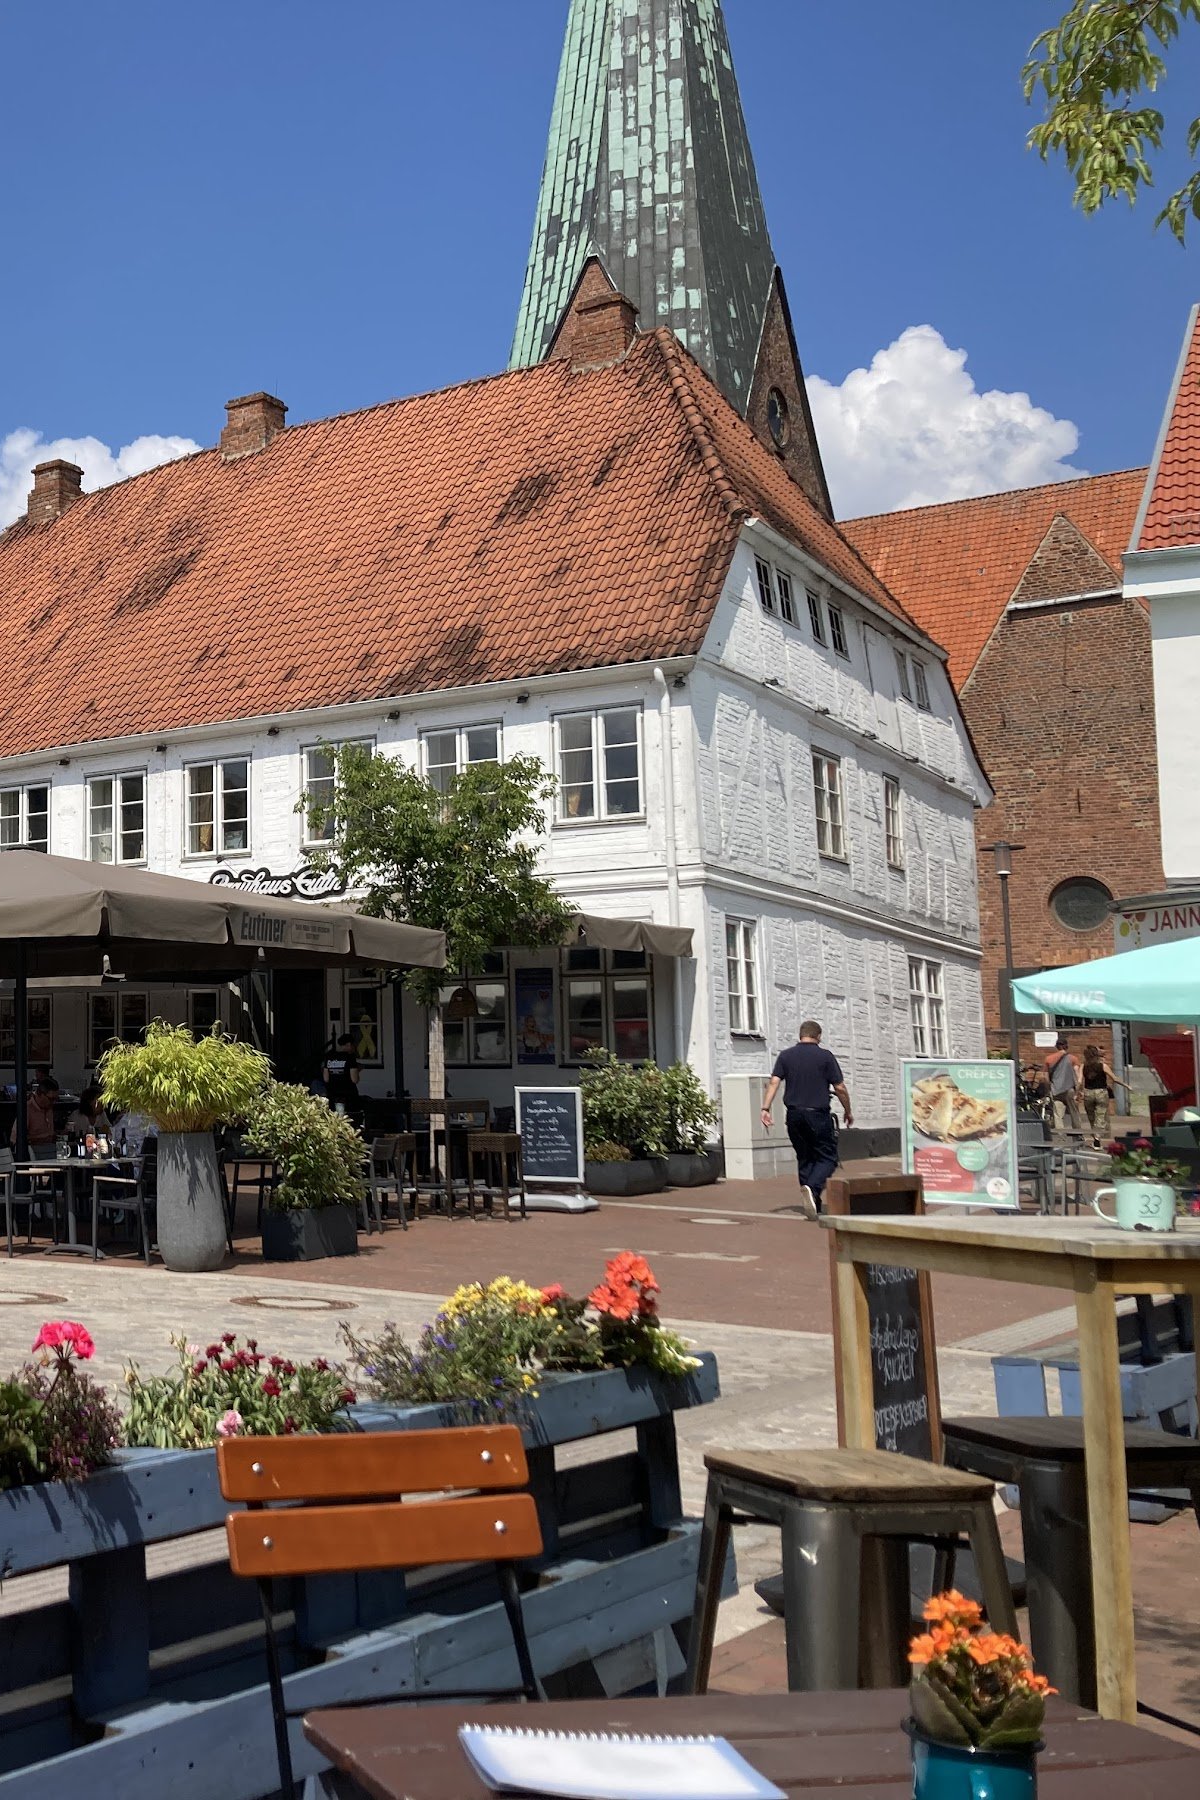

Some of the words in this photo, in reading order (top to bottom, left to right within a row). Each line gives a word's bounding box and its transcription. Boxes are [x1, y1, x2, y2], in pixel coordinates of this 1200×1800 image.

[240, 911, 287, 943] Eutiner
[957, 1067, 1006, 1080] CRÊPES
[1139, 1194, 1162, 1215] 33
